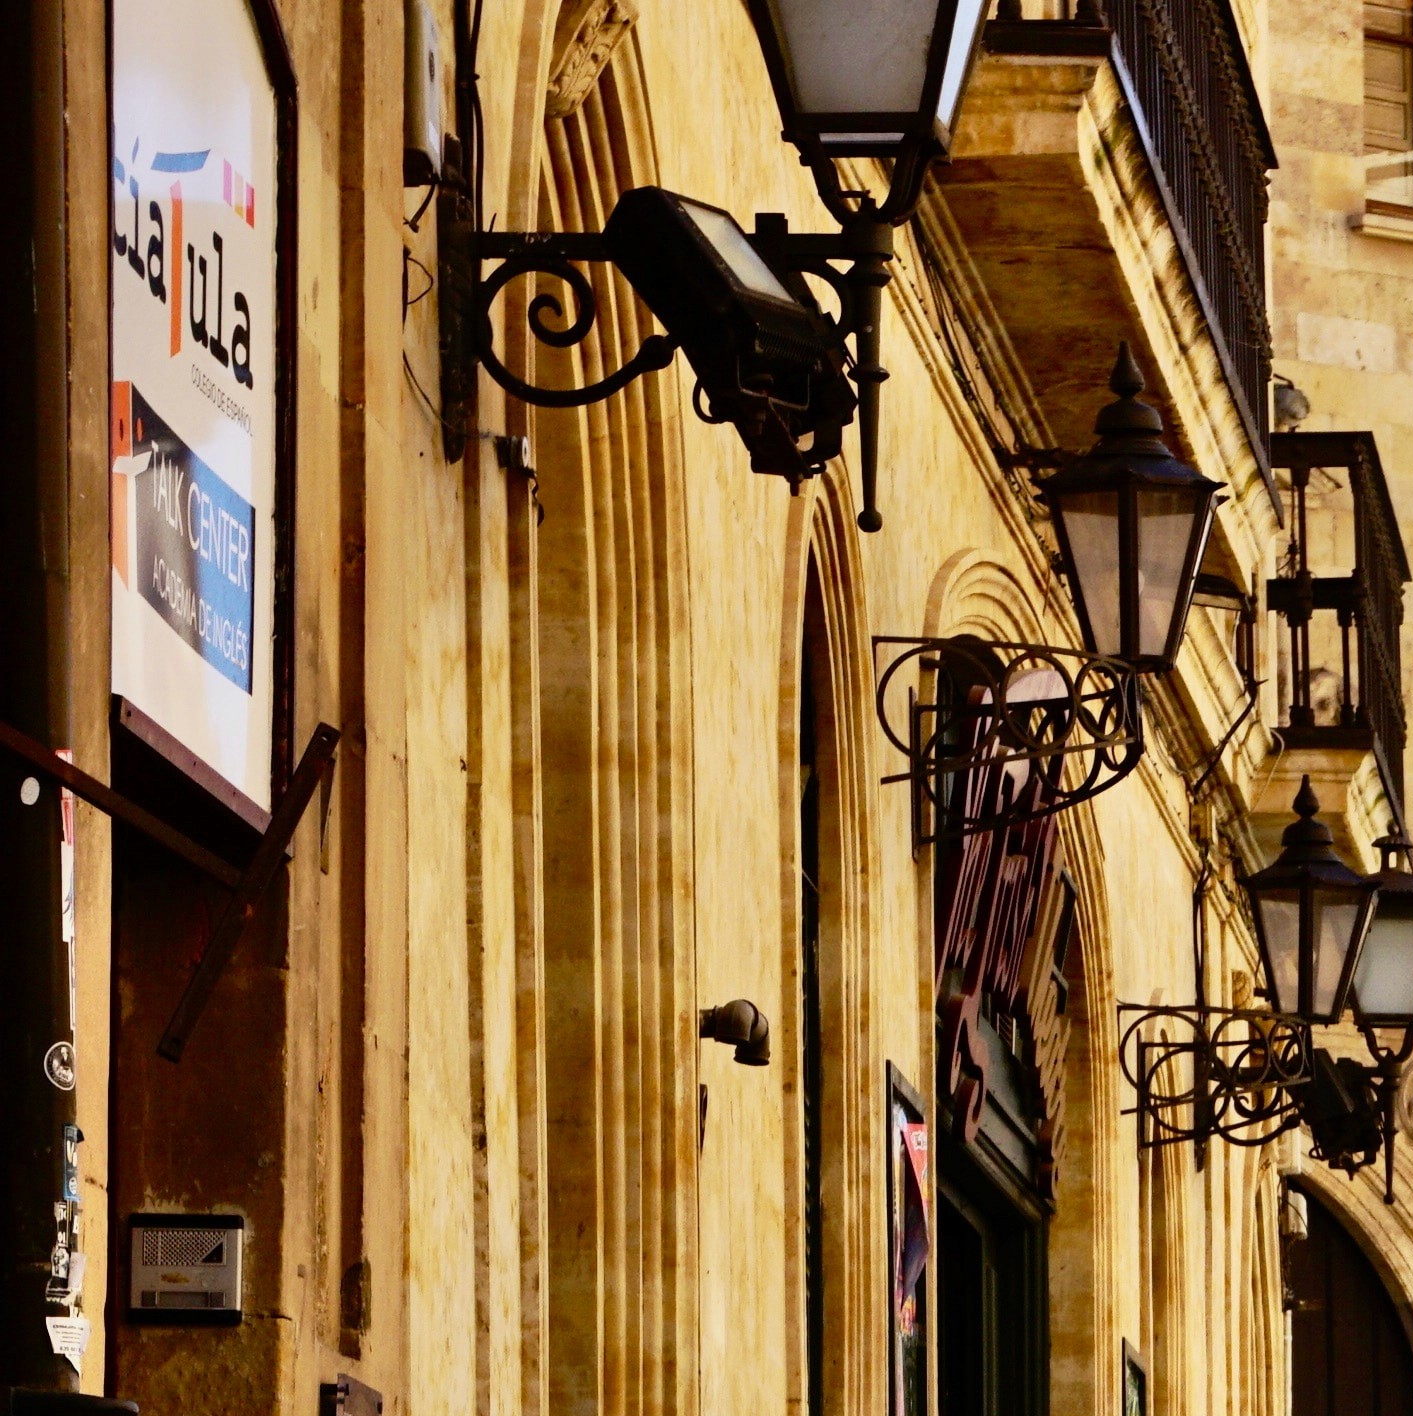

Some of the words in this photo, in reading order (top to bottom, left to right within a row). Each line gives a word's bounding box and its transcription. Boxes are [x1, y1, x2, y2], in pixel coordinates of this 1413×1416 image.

[191, 363, 217, 405] COLEGIO
[217, 387, 226, 413] DE
[226, 396, 254, 438] ESPAÑOL
[151, 440, 185, 538] TALK
[187, 481, 249, 593] CENTER
[152, 554, 197, 633] ACADEMIA
[198, 597, 212, 644] DE
[211, 617, 248, 672] INGLÉS
